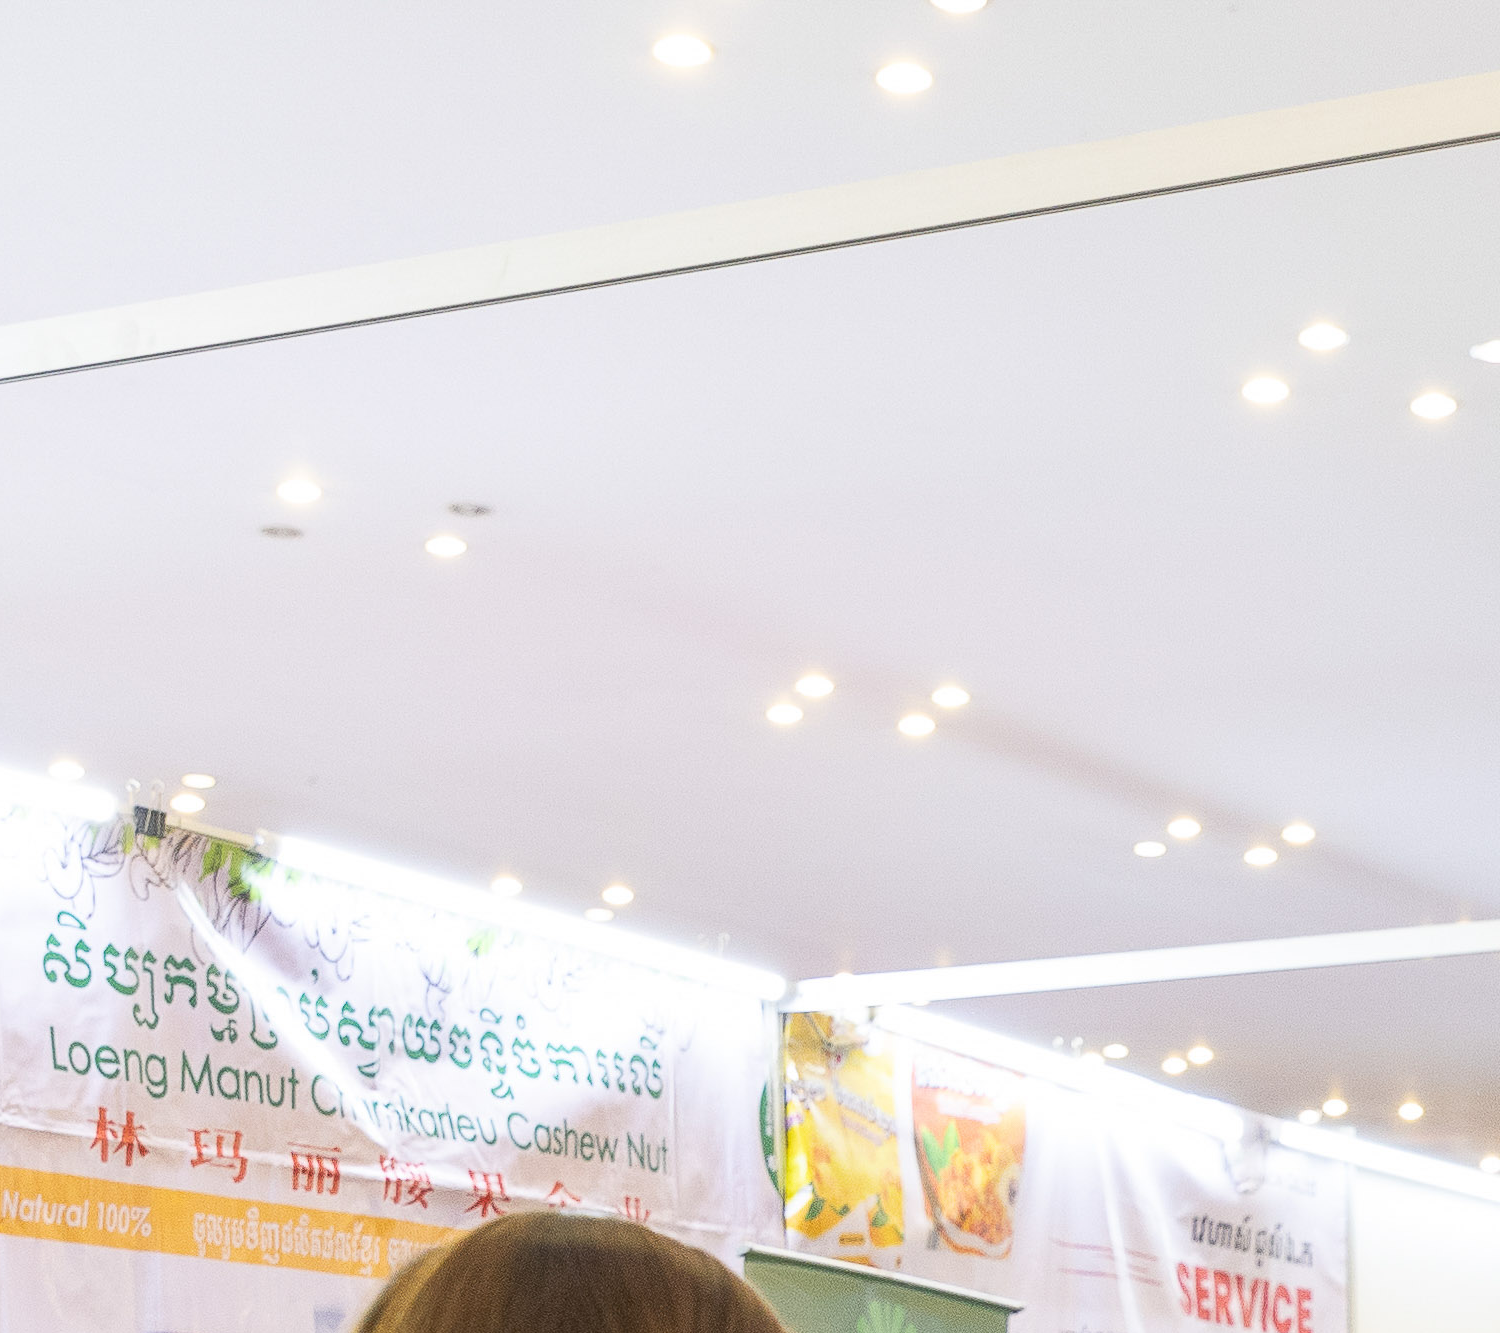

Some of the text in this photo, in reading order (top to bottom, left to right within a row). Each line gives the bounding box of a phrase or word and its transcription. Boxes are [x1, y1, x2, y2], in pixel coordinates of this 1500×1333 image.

[49, 1026, 669, 1176] Loeng Manut Chmkarleu Cashew Nut
[2, 1189, 153, 1238] Natural 100%
